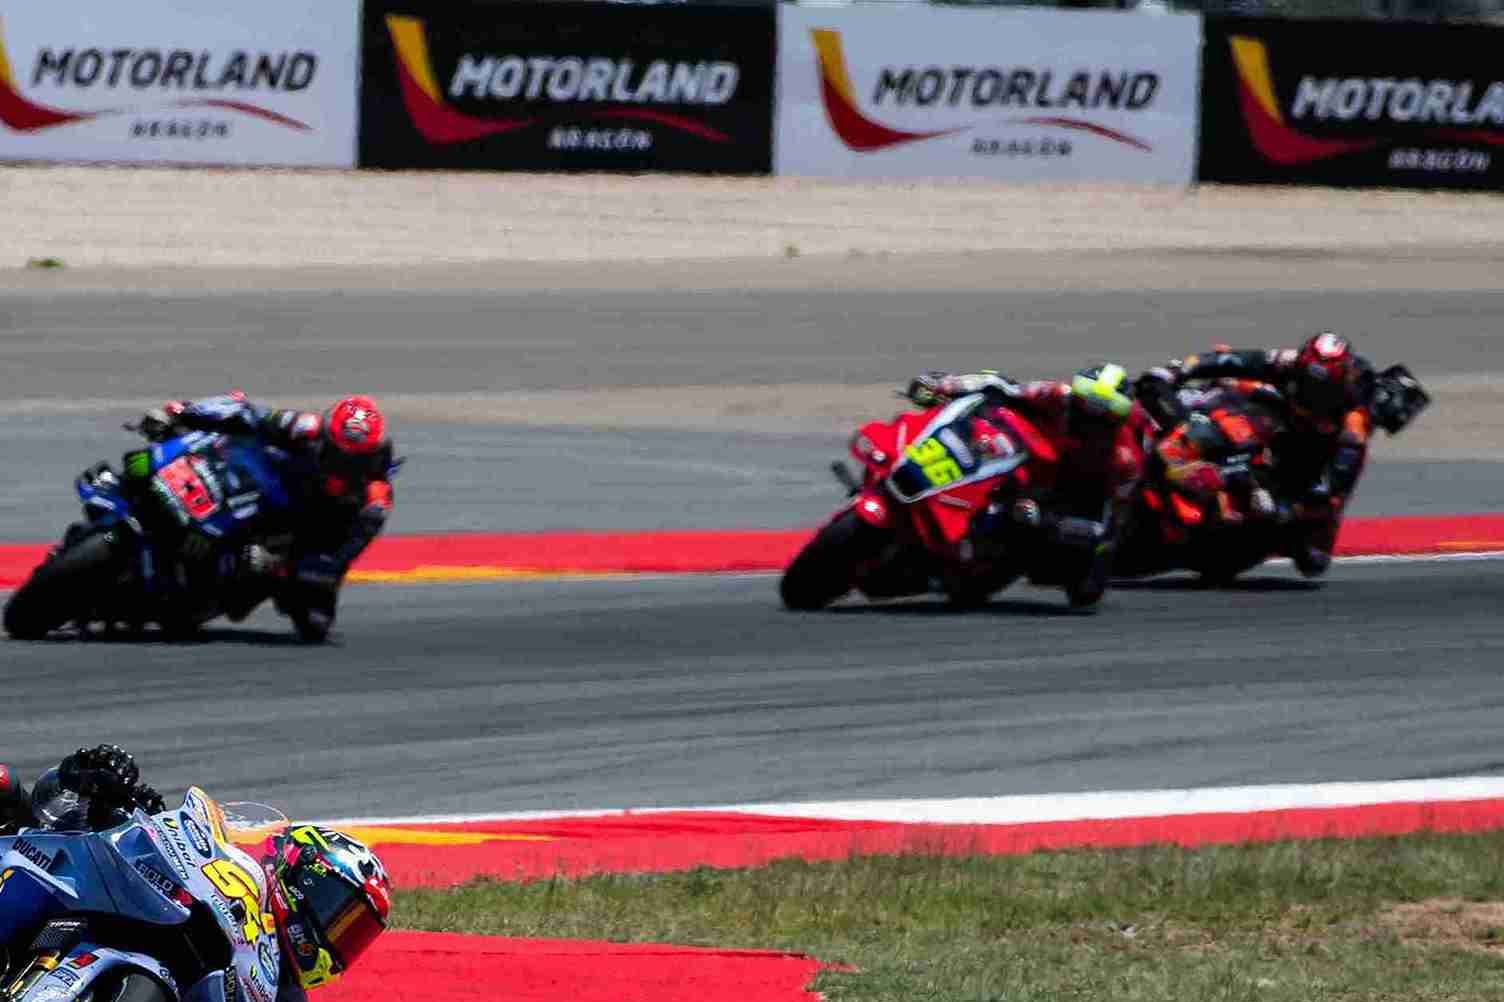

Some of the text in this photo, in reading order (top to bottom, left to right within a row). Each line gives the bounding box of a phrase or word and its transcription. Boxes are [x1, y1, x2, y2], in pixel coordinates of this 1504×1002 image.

[32, 48, 318, 92] MOTORLAND
[450, 55, 739, 104] MOTORLAND
[874, 67, 1159, 111] MOTORLAND
